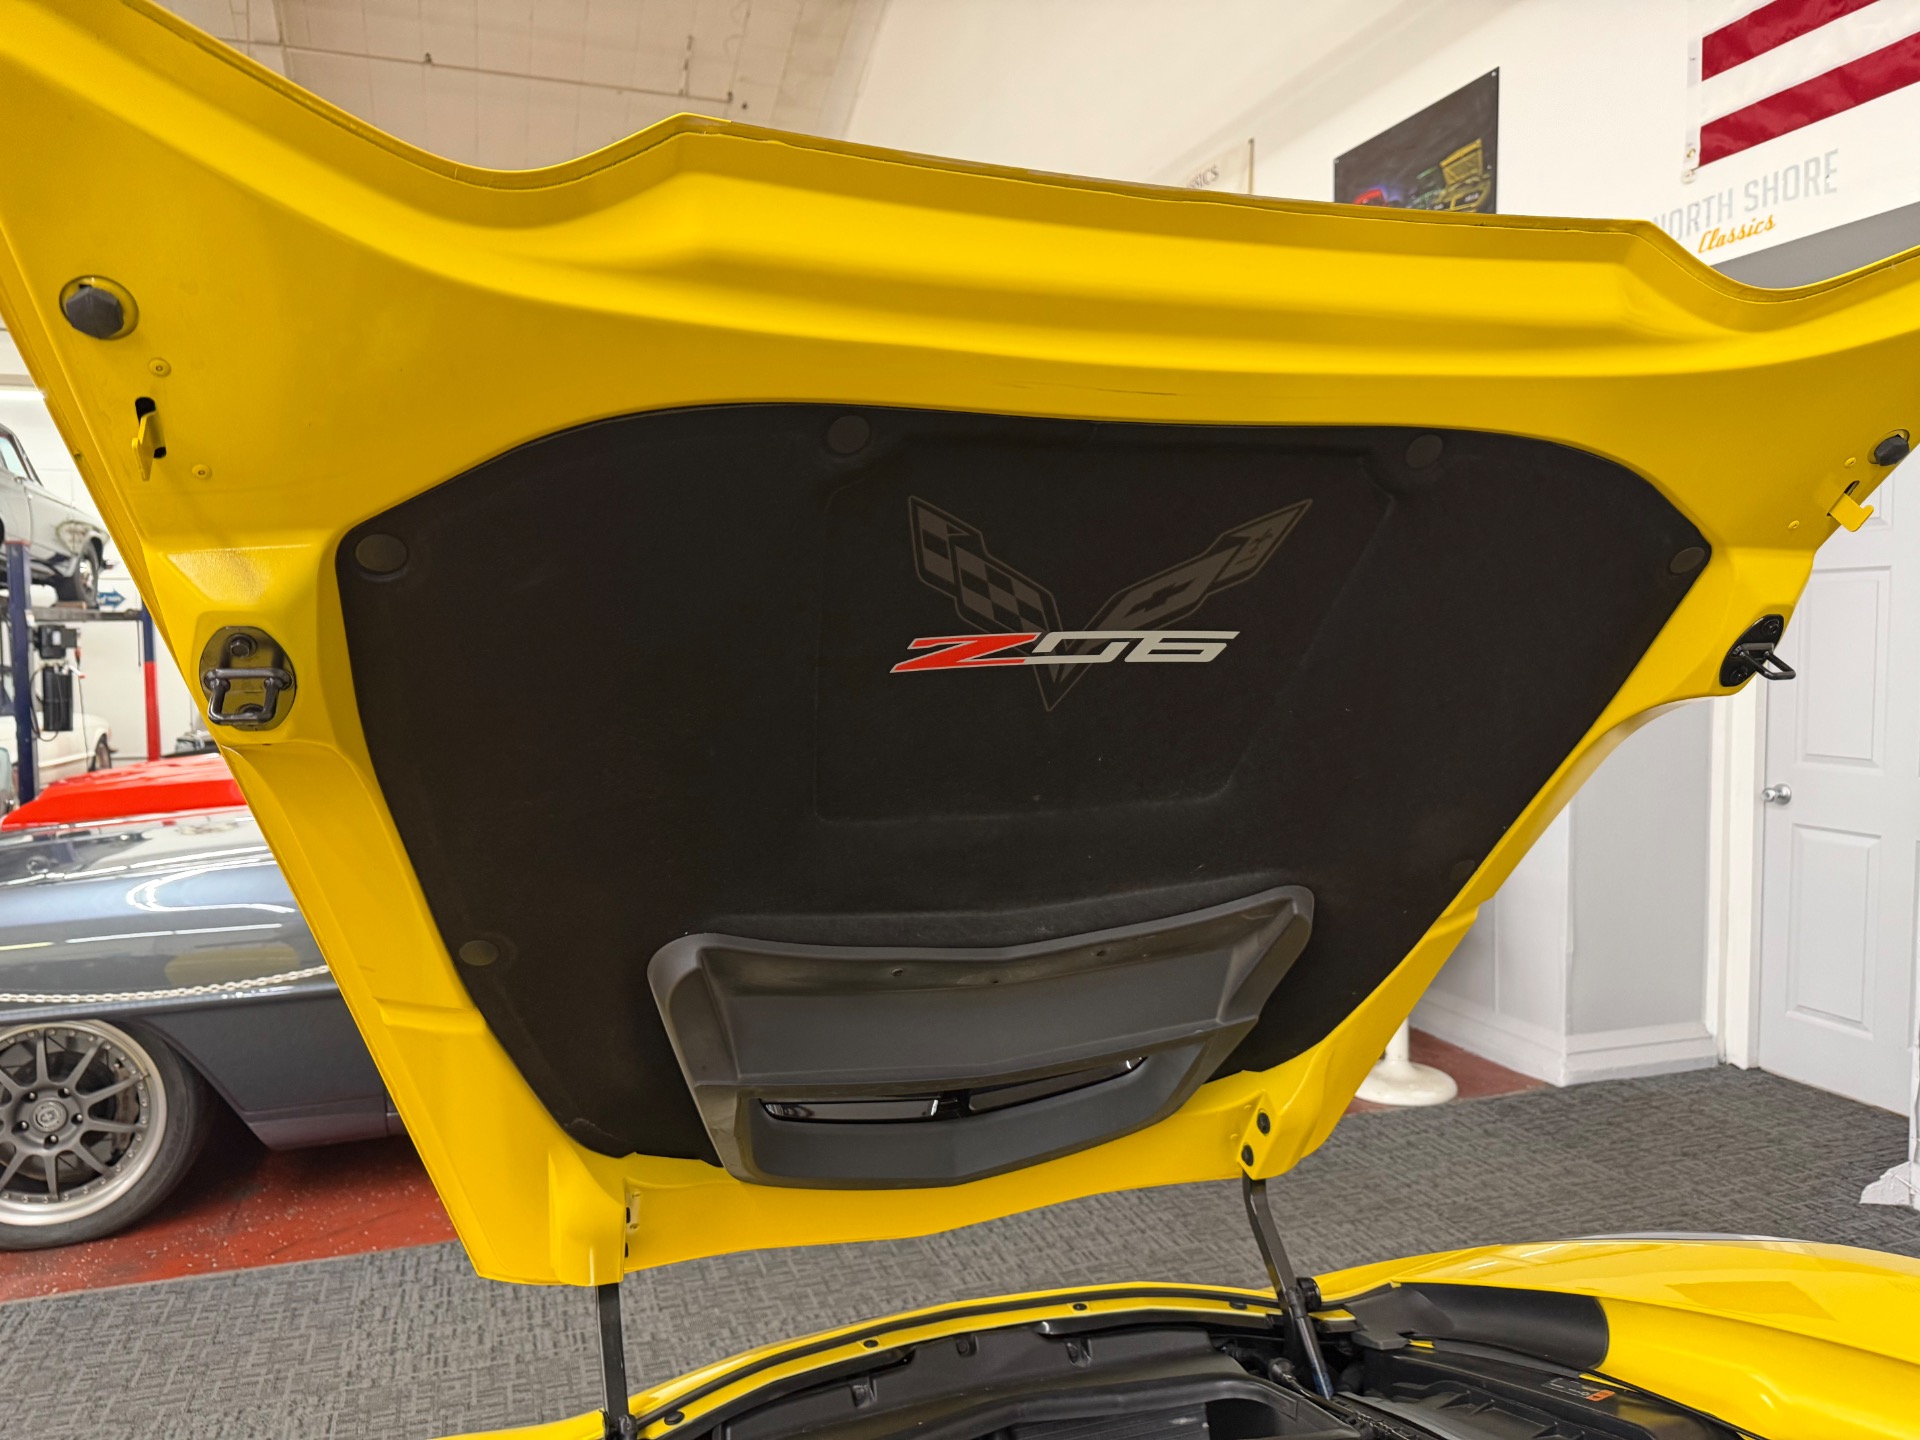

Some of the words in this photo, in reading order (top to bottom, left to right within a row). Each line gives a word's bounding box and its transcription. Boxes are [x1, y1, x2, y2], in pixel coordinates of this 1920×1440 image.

[1744, 150, 1839, 212] SHORE
[1698, 215, 1776, 254] Classics
[889, 630, 1241, 674] Z06
